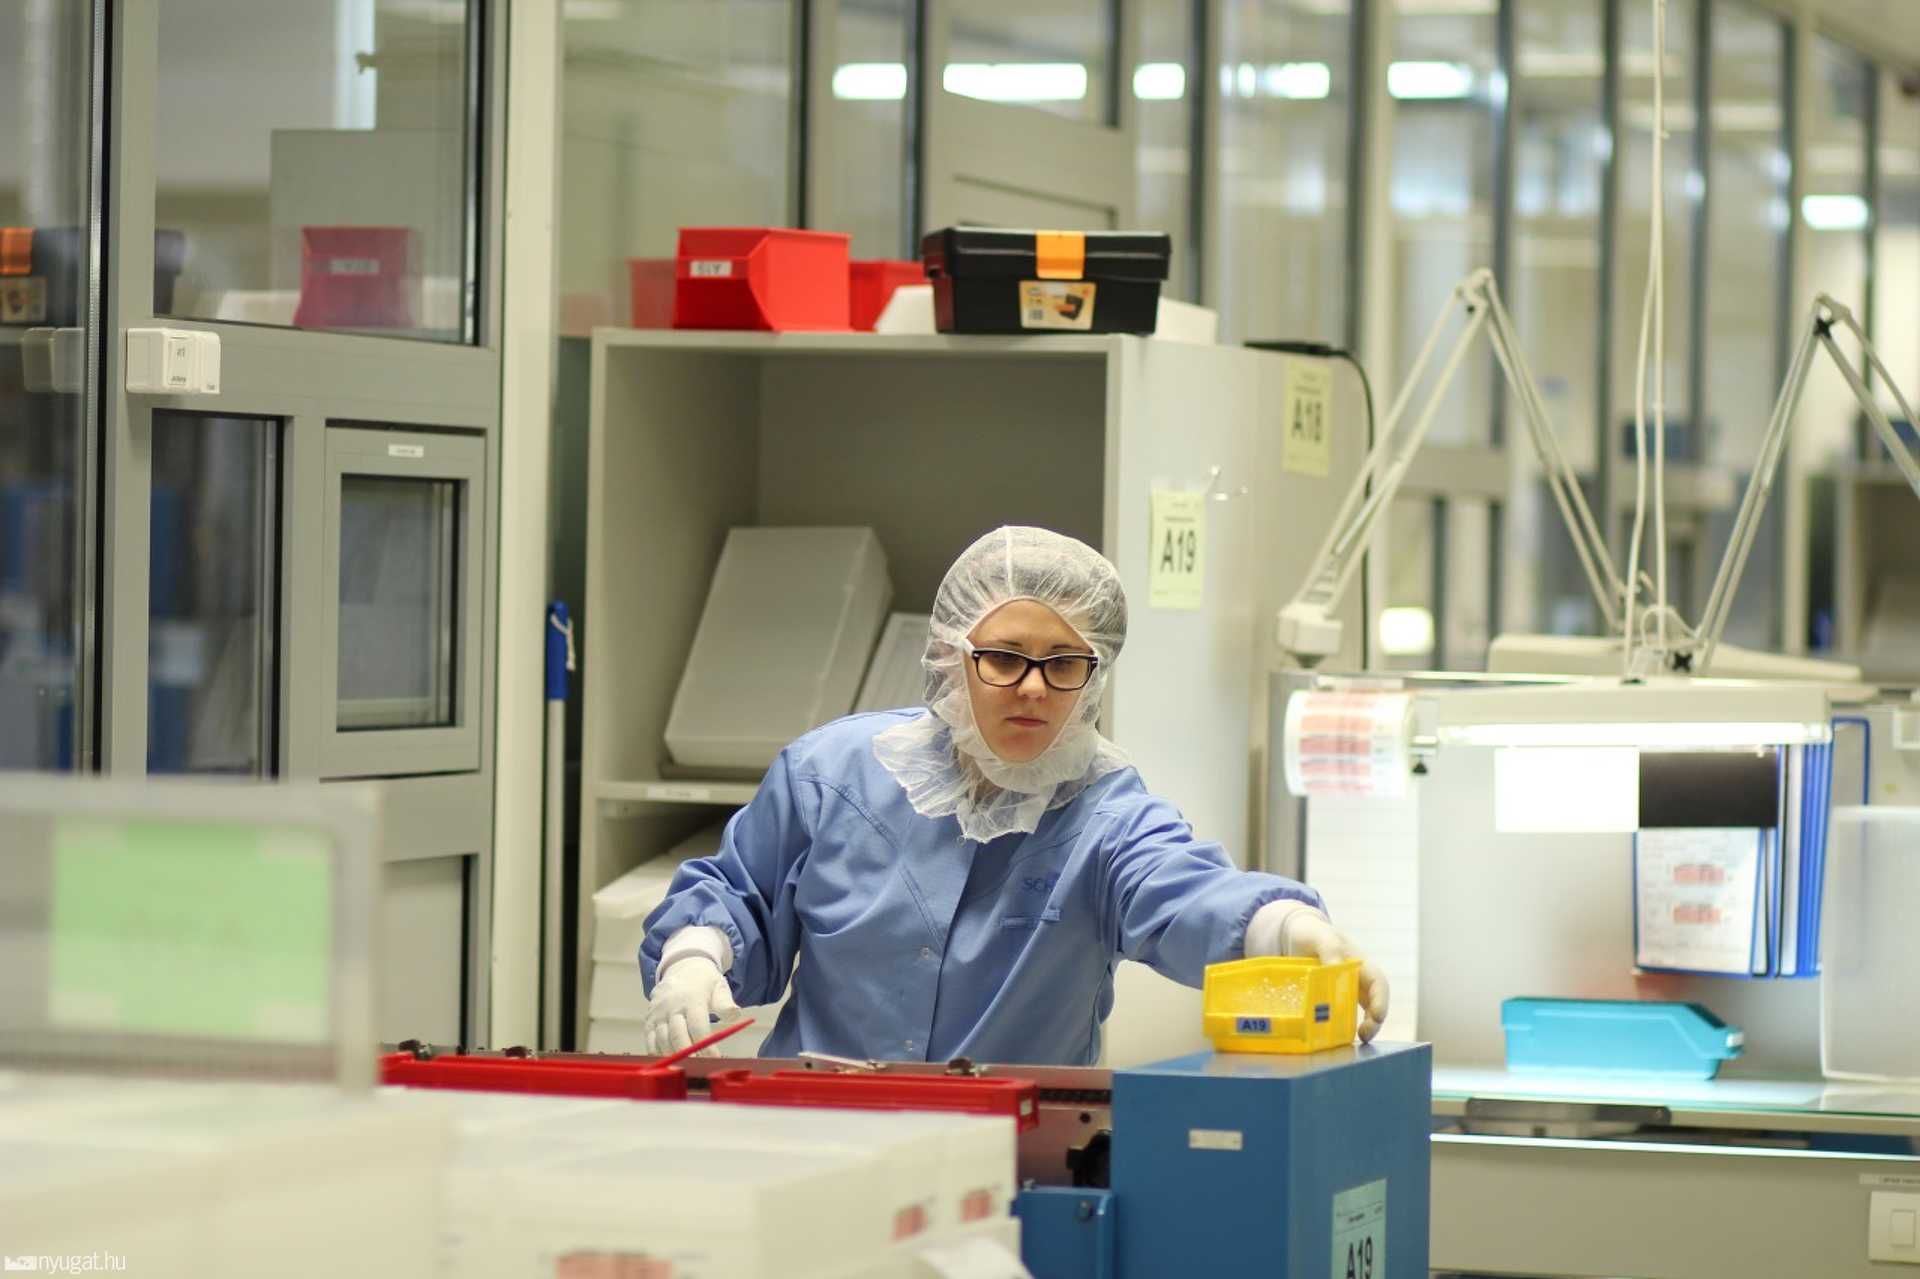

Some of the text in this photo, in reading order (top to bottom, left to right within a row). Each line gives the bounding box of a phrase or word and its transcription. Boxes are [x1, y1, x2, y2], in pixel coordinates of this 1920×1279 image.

[1160, 527, 1197, 573] A19
[1241, 1017, 1267, 1031] A19
[1346, 1235, 1373, 1279] A19
